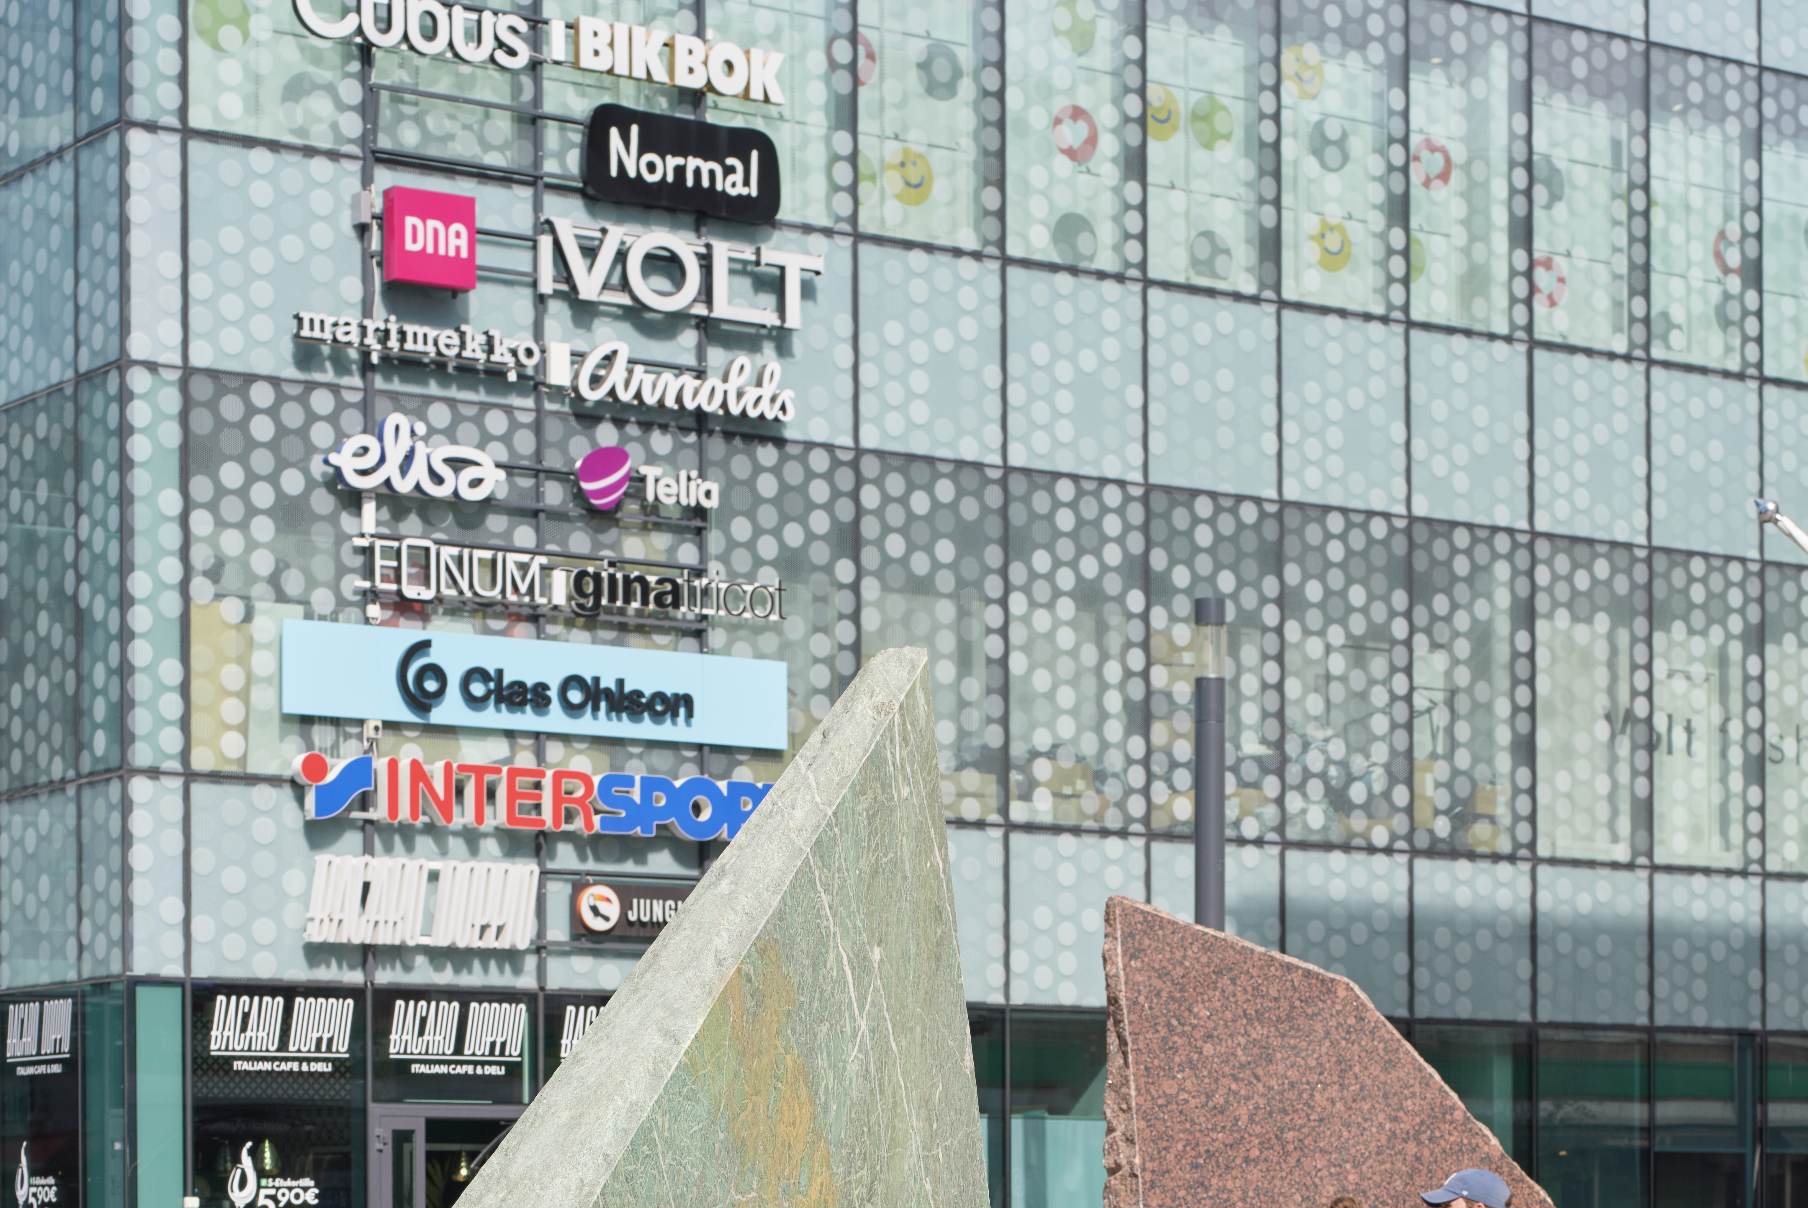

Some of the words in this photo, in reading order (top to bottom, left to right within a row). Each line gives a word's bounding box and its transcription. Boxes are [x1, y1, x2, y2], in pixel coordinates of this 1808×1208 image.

[609, 123, 759, 197] Normal
[404, 215, 468, 259] DNA
[542, 217, 824, 330] VOLT
[296, 311, 541, 367] marimekko
[576, 340, 795, 422] Arnolds
[328, 412, 506, 501] elisa
[638, 464, 720, 509] Telia
[460, 667, 552, 710] Clas
[558, 674, 695, 726] Ohlson
[385, 756, 774, 841] INTERSPOR
[303, 854, 429, 947] BACARO
[429, 860, 540, 951] DOPPIO
[627, 898, 683, 923] JUNG
[6, 1001, 40, 1058] BACARO
[41, 998, 72, 1055] DOPPIO
[210, 995, 284, 1052] BACARO
[289, 997, 354, 1053] DOPPIO
[389, 1000, 460, 1055] BACARO
[463, 1002, 526, 1056] DOPPIO
[233, 1061, 272, 1071] ITALIAN
[273, 1061, 300, 1072] CAFE
[301, 1061, 309, 1072] &
[310, 1062, 332, 1073] DELI
[411, 1064, 448, 1074] ITALIAN
[449, 1064, 475, 1075] CAFE
[476, 1065, 483, 1075] &
[484, 1065, 505, 1076] DELI
